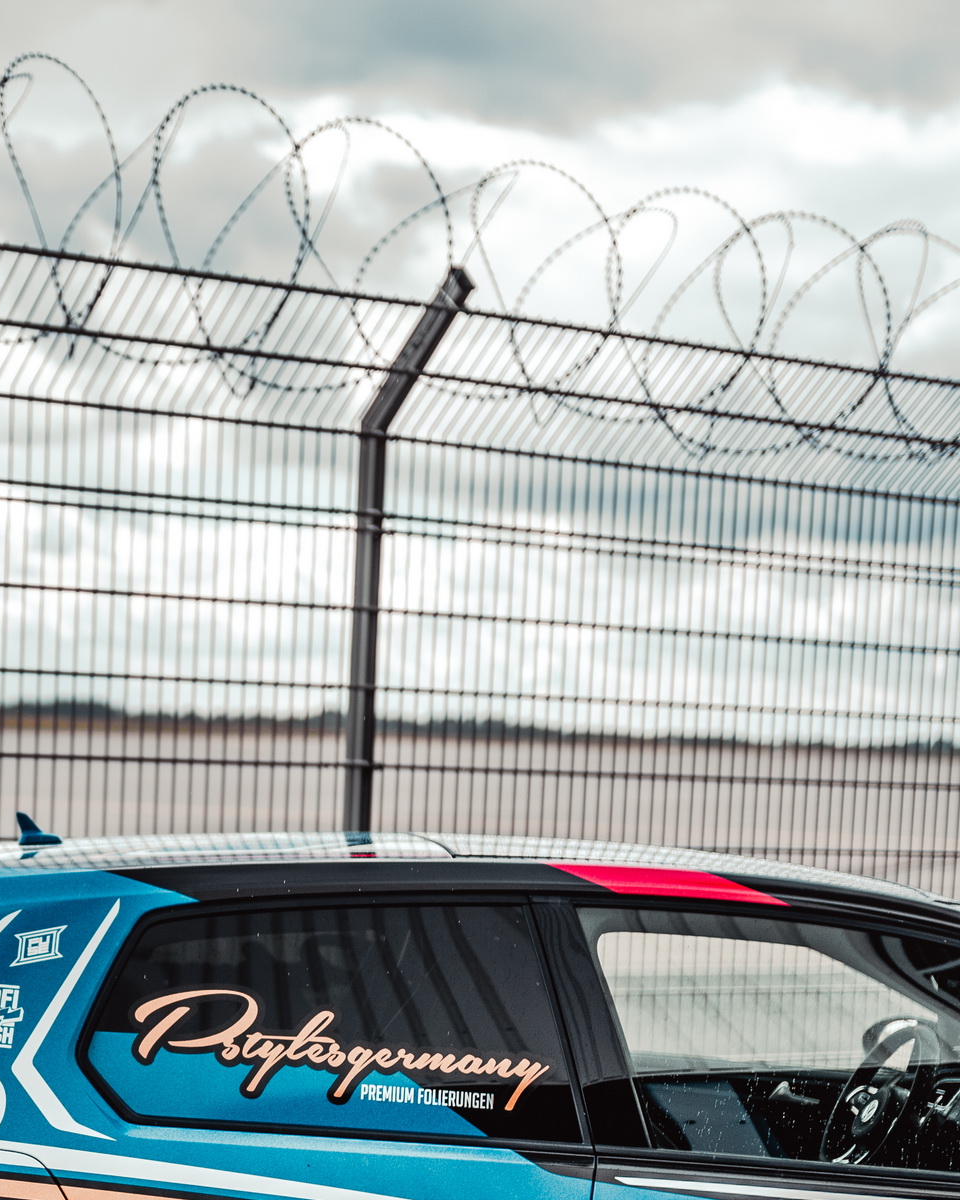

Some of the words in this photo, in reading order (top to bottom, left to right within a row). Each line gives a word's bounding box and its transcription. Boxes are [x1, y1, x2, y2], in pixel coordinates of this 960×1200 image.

[135, 989, 550, 1111] Pstylesgermany
[360, 1083, 415, 1104] PREMIUM
[417, 1088, 495, 1110] FOLIERUNGEN
